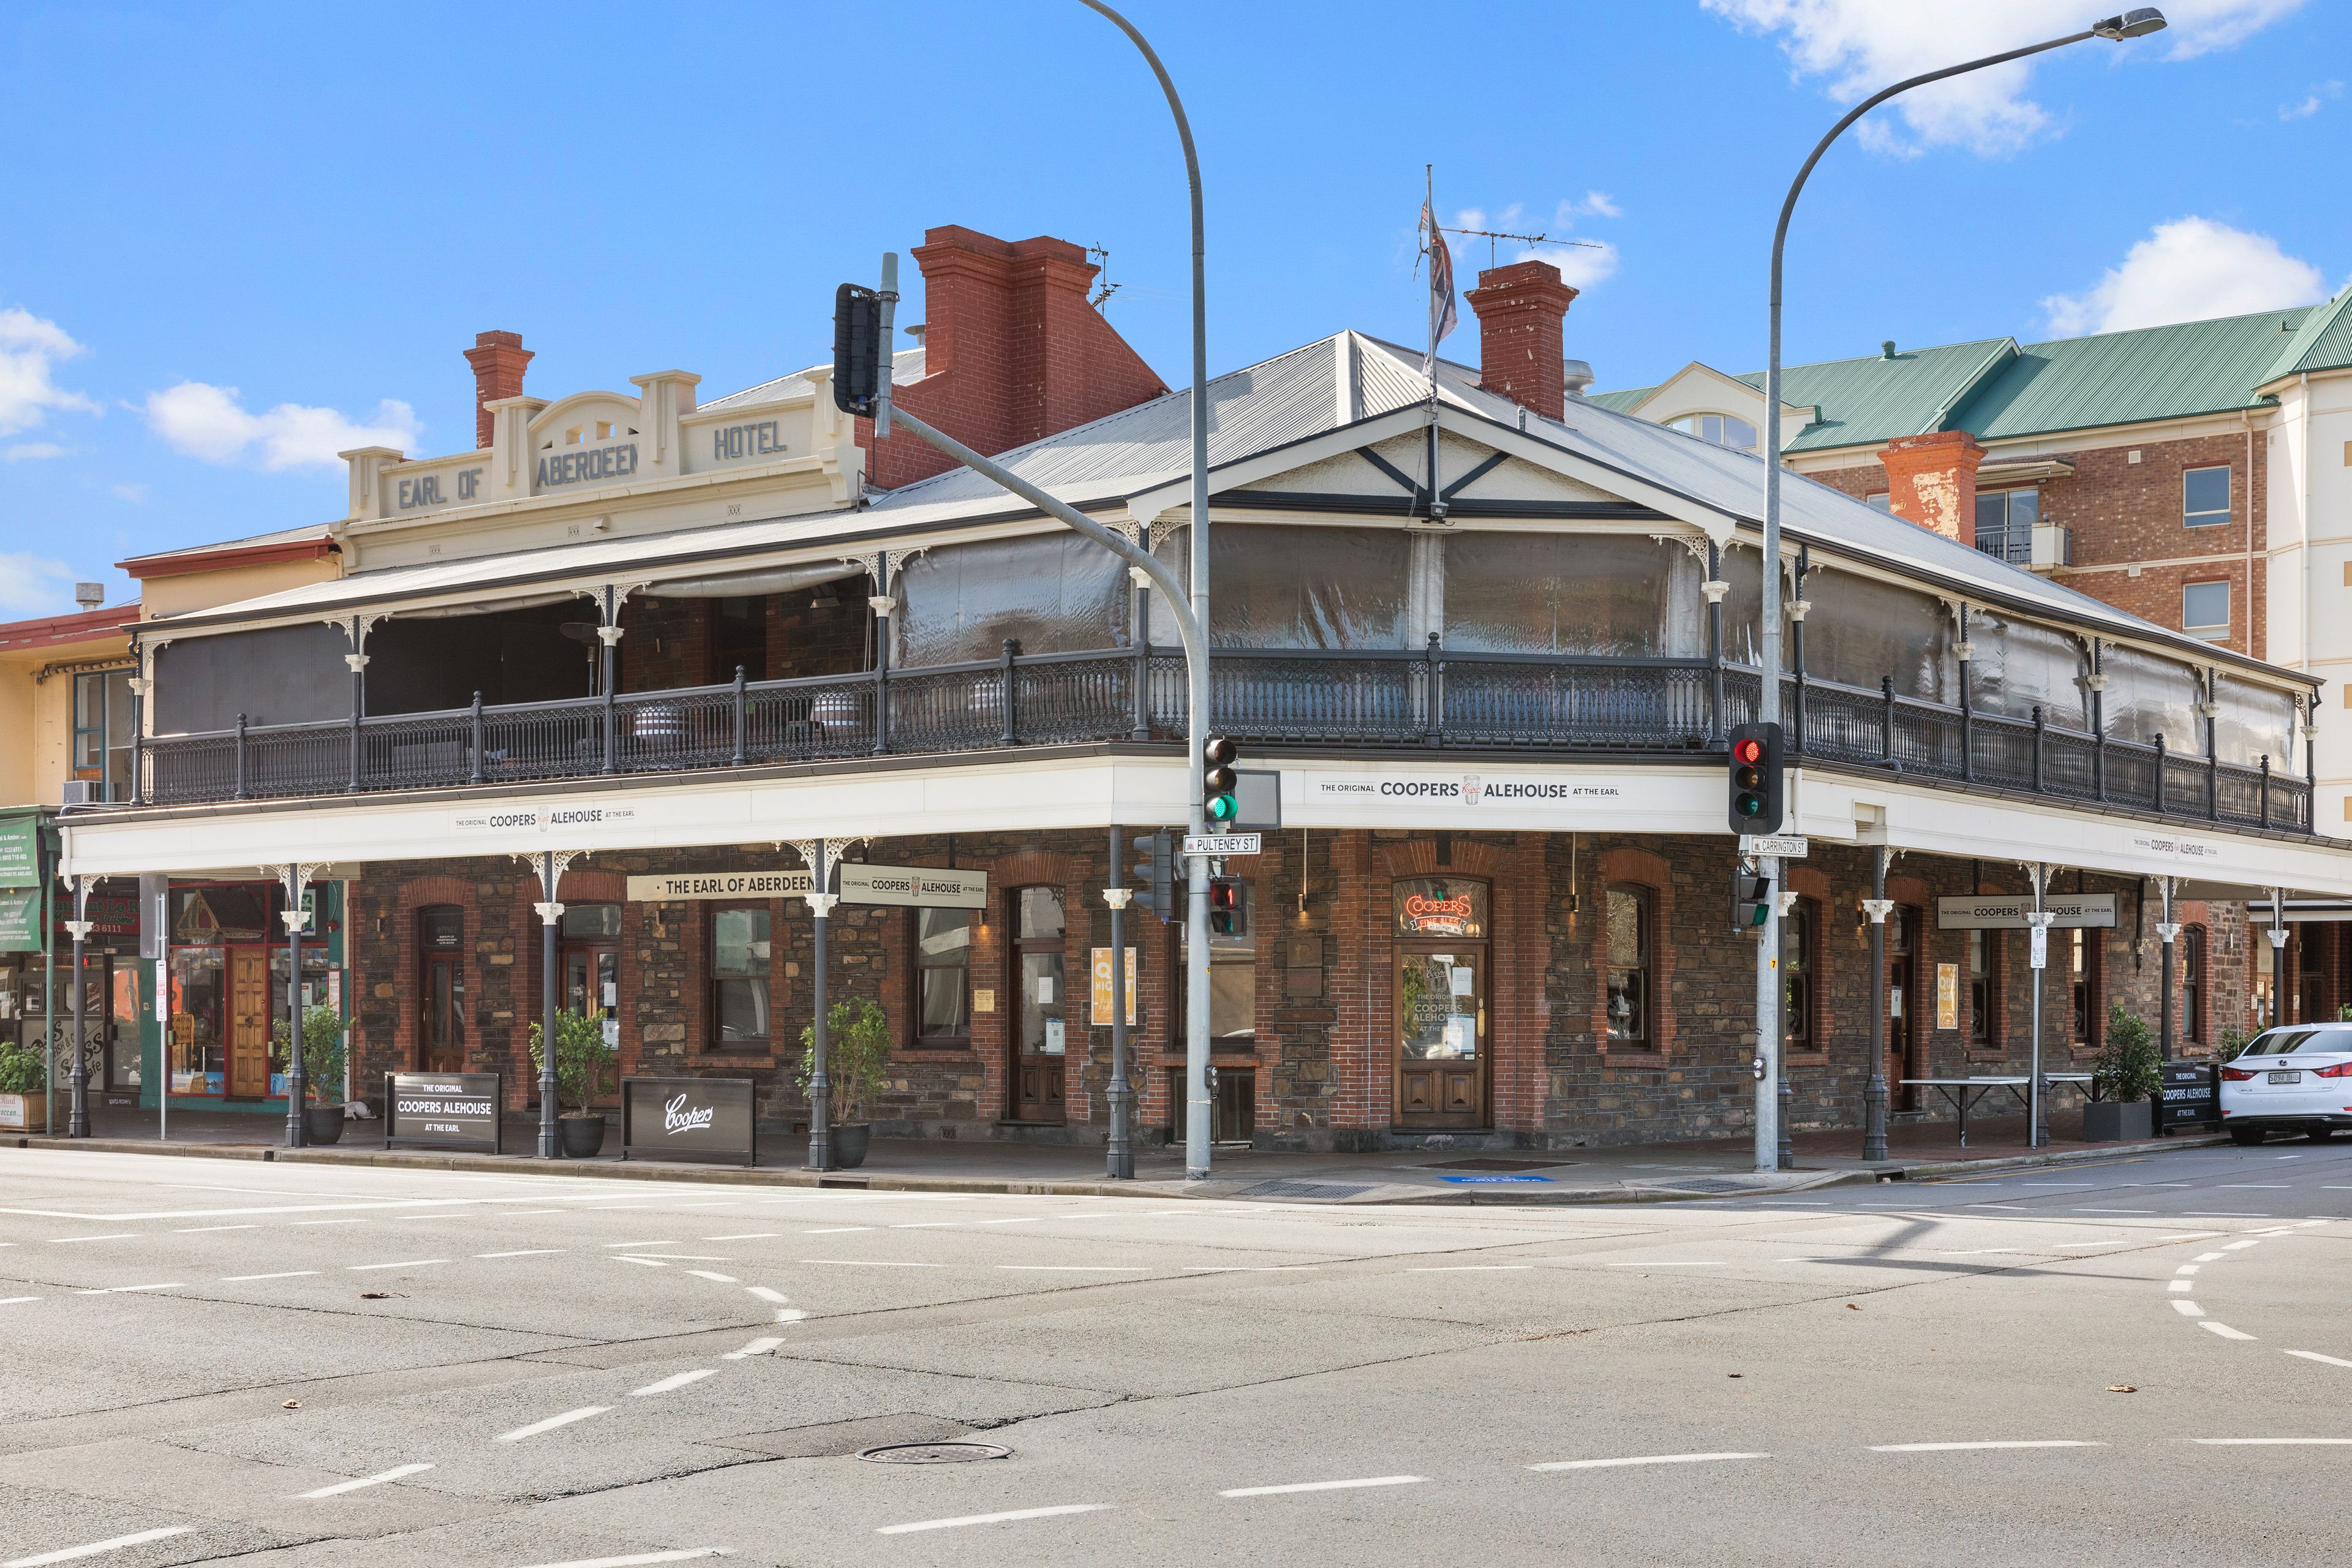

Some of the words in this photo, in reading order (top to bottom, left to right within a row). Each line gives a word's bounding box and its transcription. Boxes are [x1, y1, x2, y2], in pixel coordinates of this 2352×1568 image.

[715, 421, 787, 460] HOTEL
[537, 443, 639, 488] ABERDEEN
[399, 476, 447, 509] EARL
[458, 468, 483, 500] OF
[1381, 782, 1459, 796] COOPERS
[1461, 782, 1481, 794] Coopers
[1484, 784, 1567, 797] ALEHOUSE
[490, 813, 536, 827] COOPERS
[551, 810, 602, 824] ALEHOUSE
[1197, 839, 1242, 851] PULTENEY
[1243, 838, 1254, 850] ST
[1762, 840, 1797, 853] CARRINGTON
[1798, 842, 1804, 853] ST
[2151, 839, 2174, 852] COOPERS
[2180, 843, 2204, 856] ALEHOUSE
[666, 880, 690, 894] THE
[693, 879, 724, 893] EARL
[728, 878, 744, 892] OF
[748, 876, 815, 891] ABERDEEN
[872, 880, 910, 891] COOPERS
[922, 883, 960, 893] ALEHOUSE
[1406, 894, 1471, 917] COOPERS
[1974, 908, 2019, 917] COOPERS
[1420, 918, 1437, 927] FINE
[2036, 929, 2043, 939] 1P
[1096, 979, 1134, 993] NIGT
[2163, 1088, 2185, 1101] COOPERS
[2187, 1088, 2211, 1099] ALEHOUSE
[398, 1101, 441, 1113] COOPERS
[443, 1102, 492, 1115] ALEHOUSE
[665, 1093, 714, 1133] Coopers
